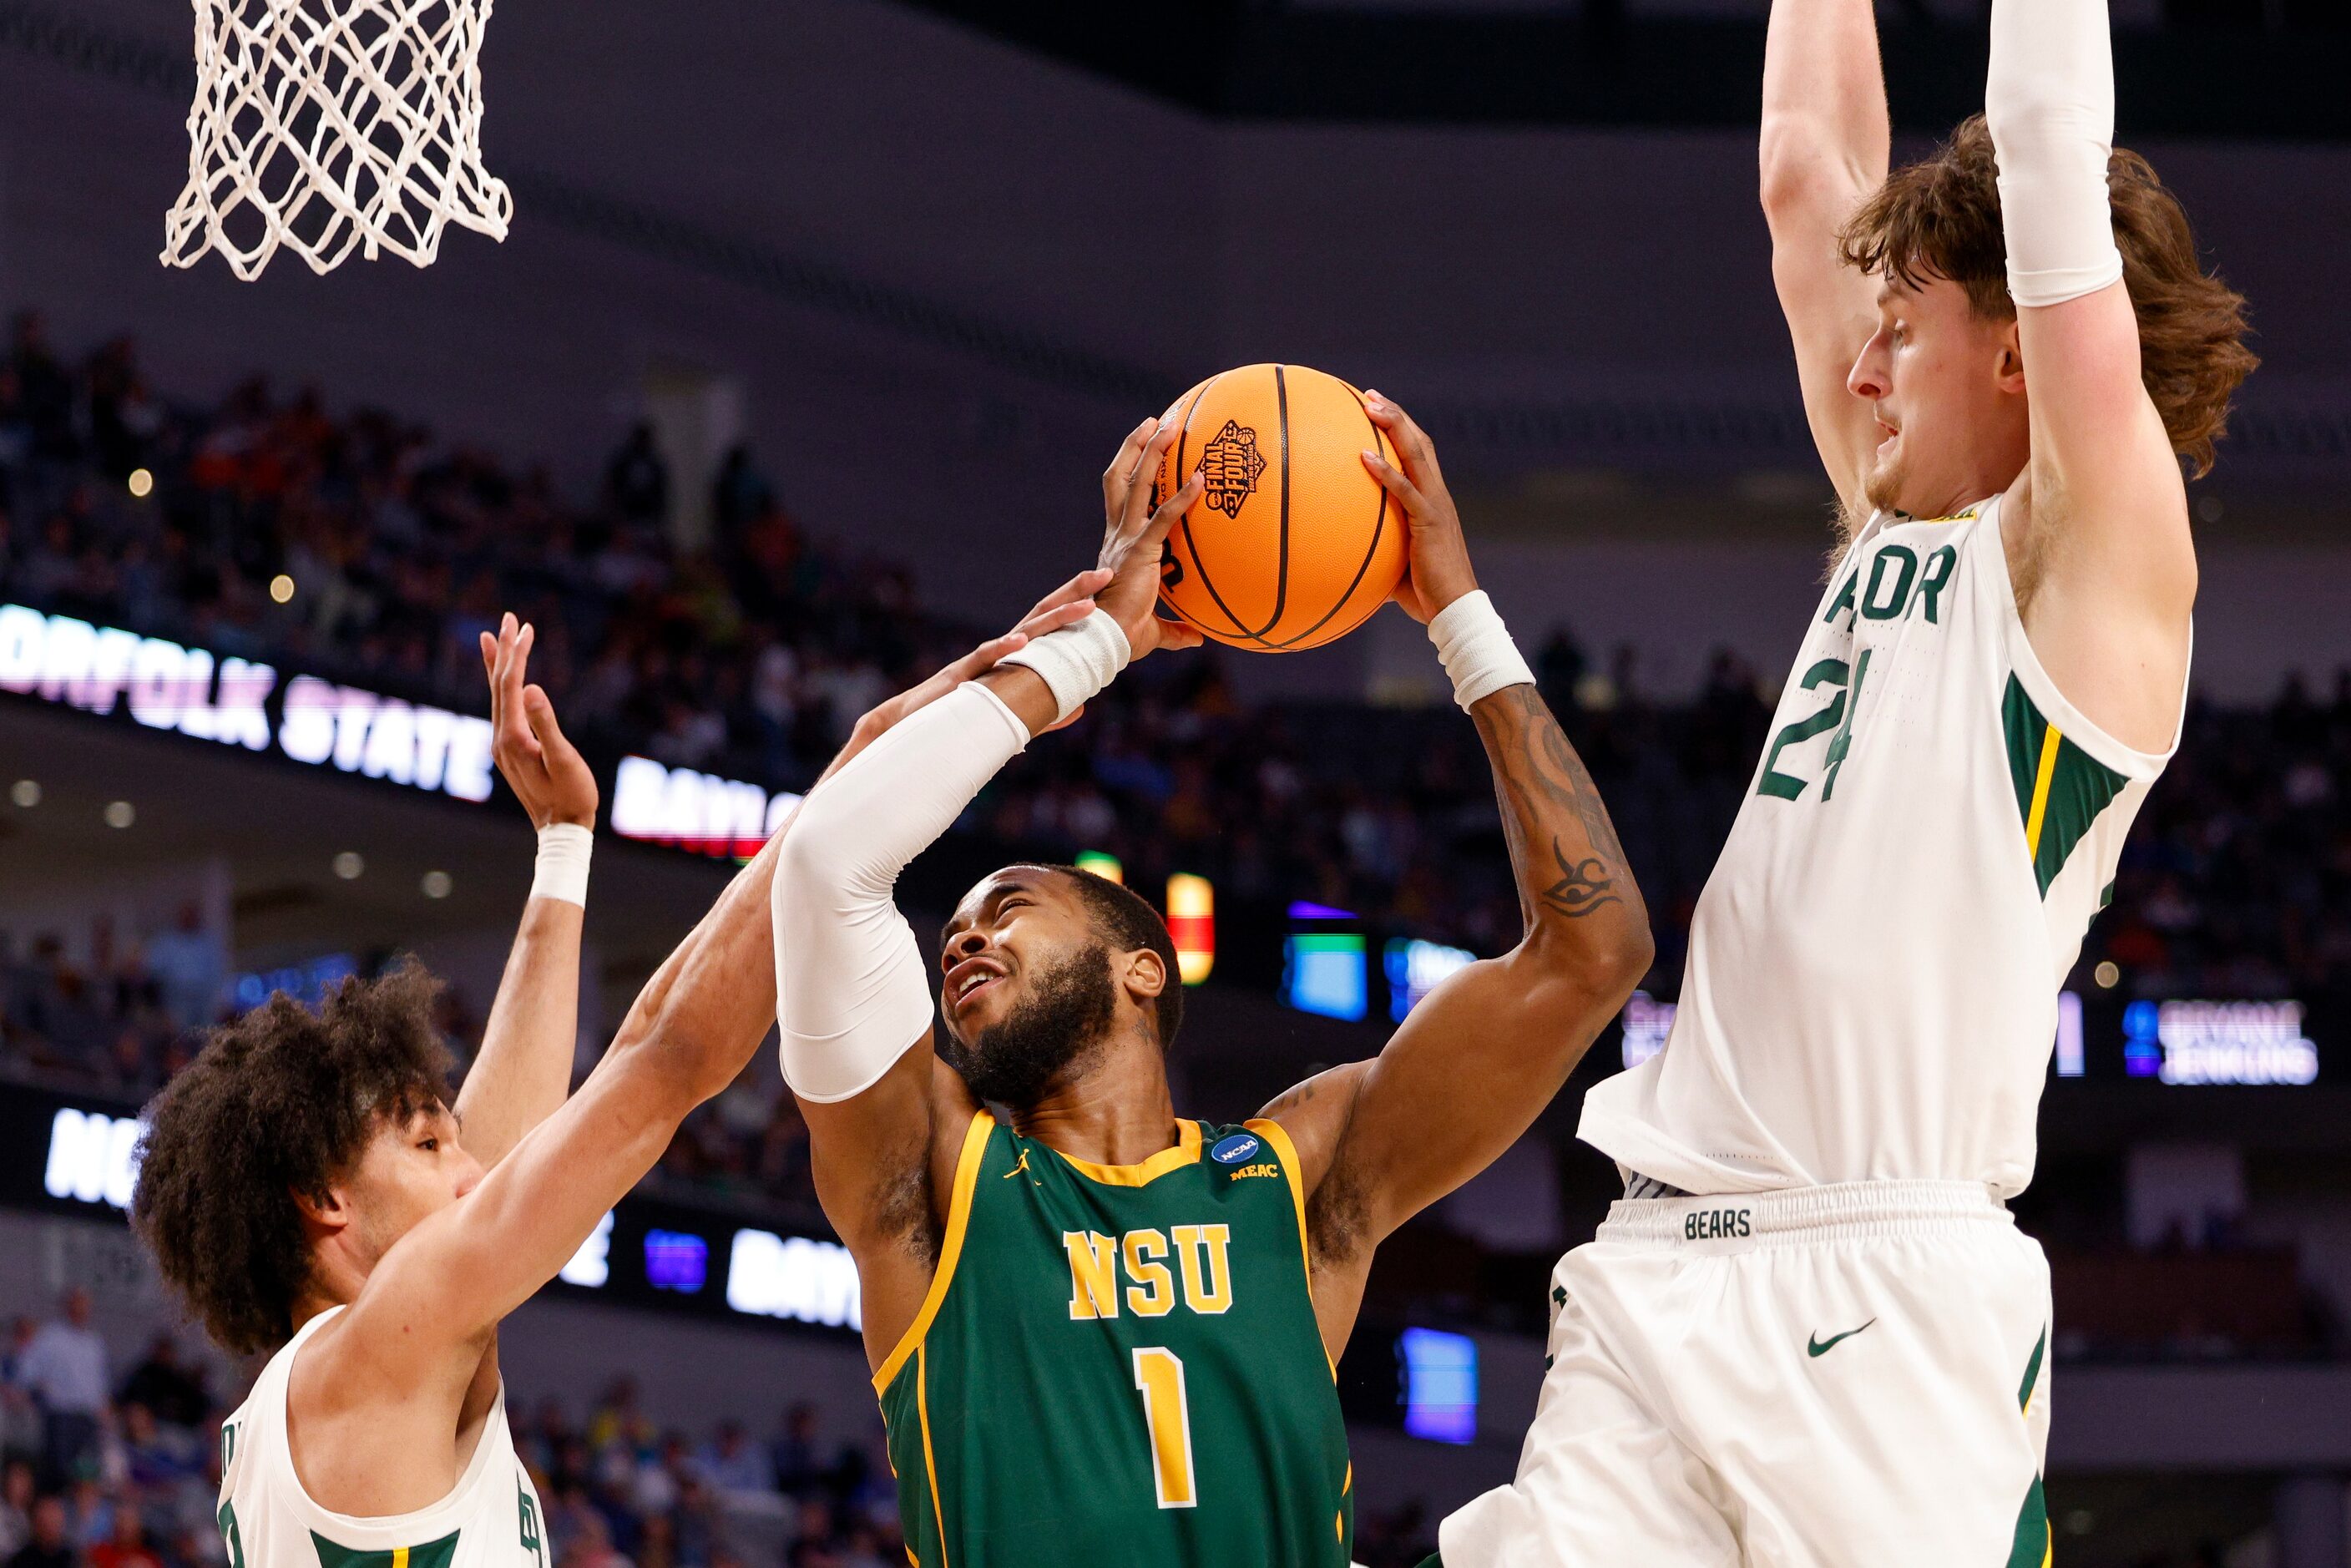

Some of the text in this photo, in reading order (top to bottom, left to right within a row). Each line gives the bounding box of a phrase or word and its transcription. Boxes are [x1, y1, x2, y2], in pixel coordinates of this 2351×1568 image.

[1206, 442, 1224, 491] FINAL
[1224, 441, 1245, 491] FOUR
[278, 674, 494, 803] STATE
[1221, 1139, 1257, 1161] NCAA
[1229, 1164, 1279, 1182] MEAC
[1685, 1208, 1751, 1241] BEARS
[1063, 1223, 1233, 1321] NSU
[1131, 1346, 1198, 1510] 1
